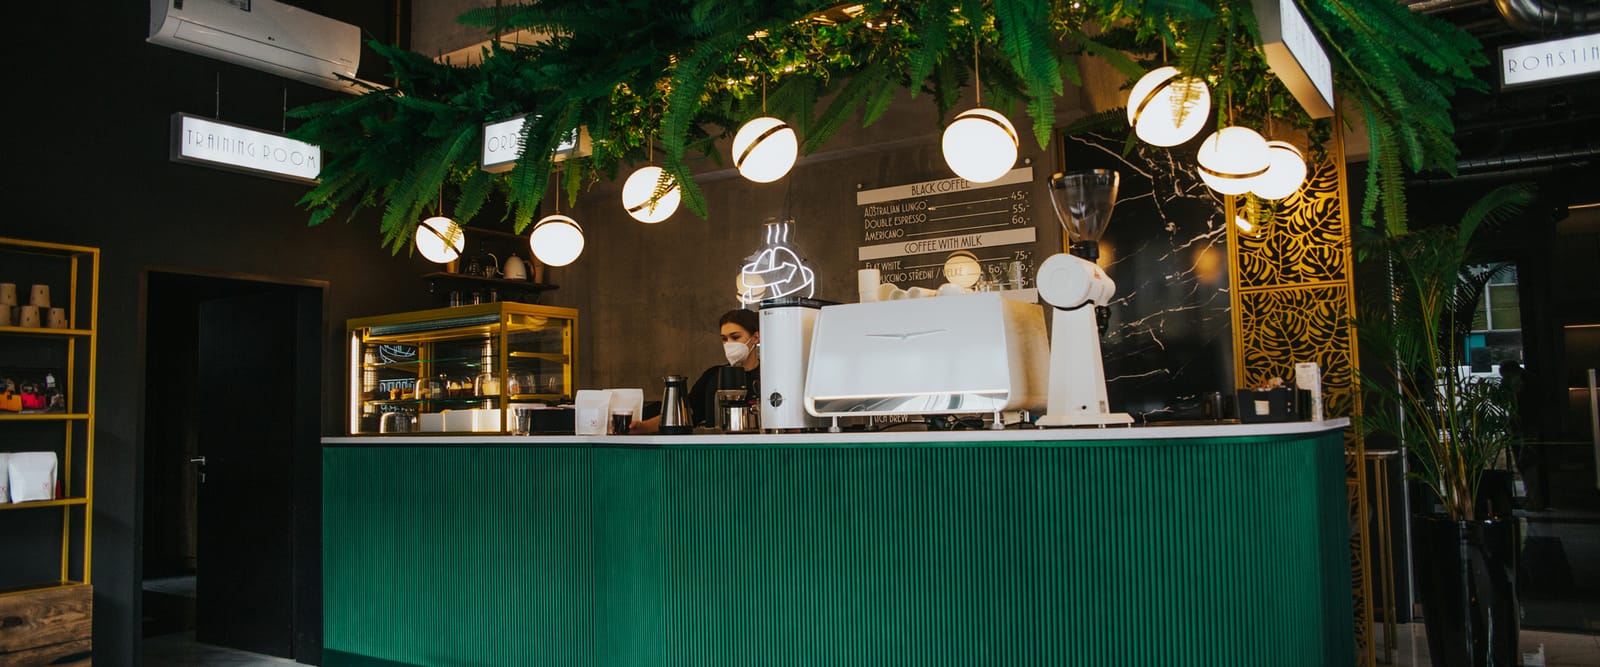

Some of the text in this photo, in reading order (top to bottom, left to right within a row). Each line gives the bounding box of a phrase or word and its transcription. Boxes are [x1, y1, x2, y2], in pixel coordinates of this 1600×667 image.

[186, 129, 316, 169] TRAINING ROOM
[911, 182, 936, 196] BLACK
[864, 204, 900, 217] AUSTRALIAN
[901, 201, 927, 213] LUNGO
[864, 217, 893, 230] DOUBLE
[894, 213, 927, 226] ESPRESSO
[865, 229, 904, 241] AMERICANO
[905, 234, 983, 254] COFFEE WITH MILK
[881, 261, 901, 271] WHITE
